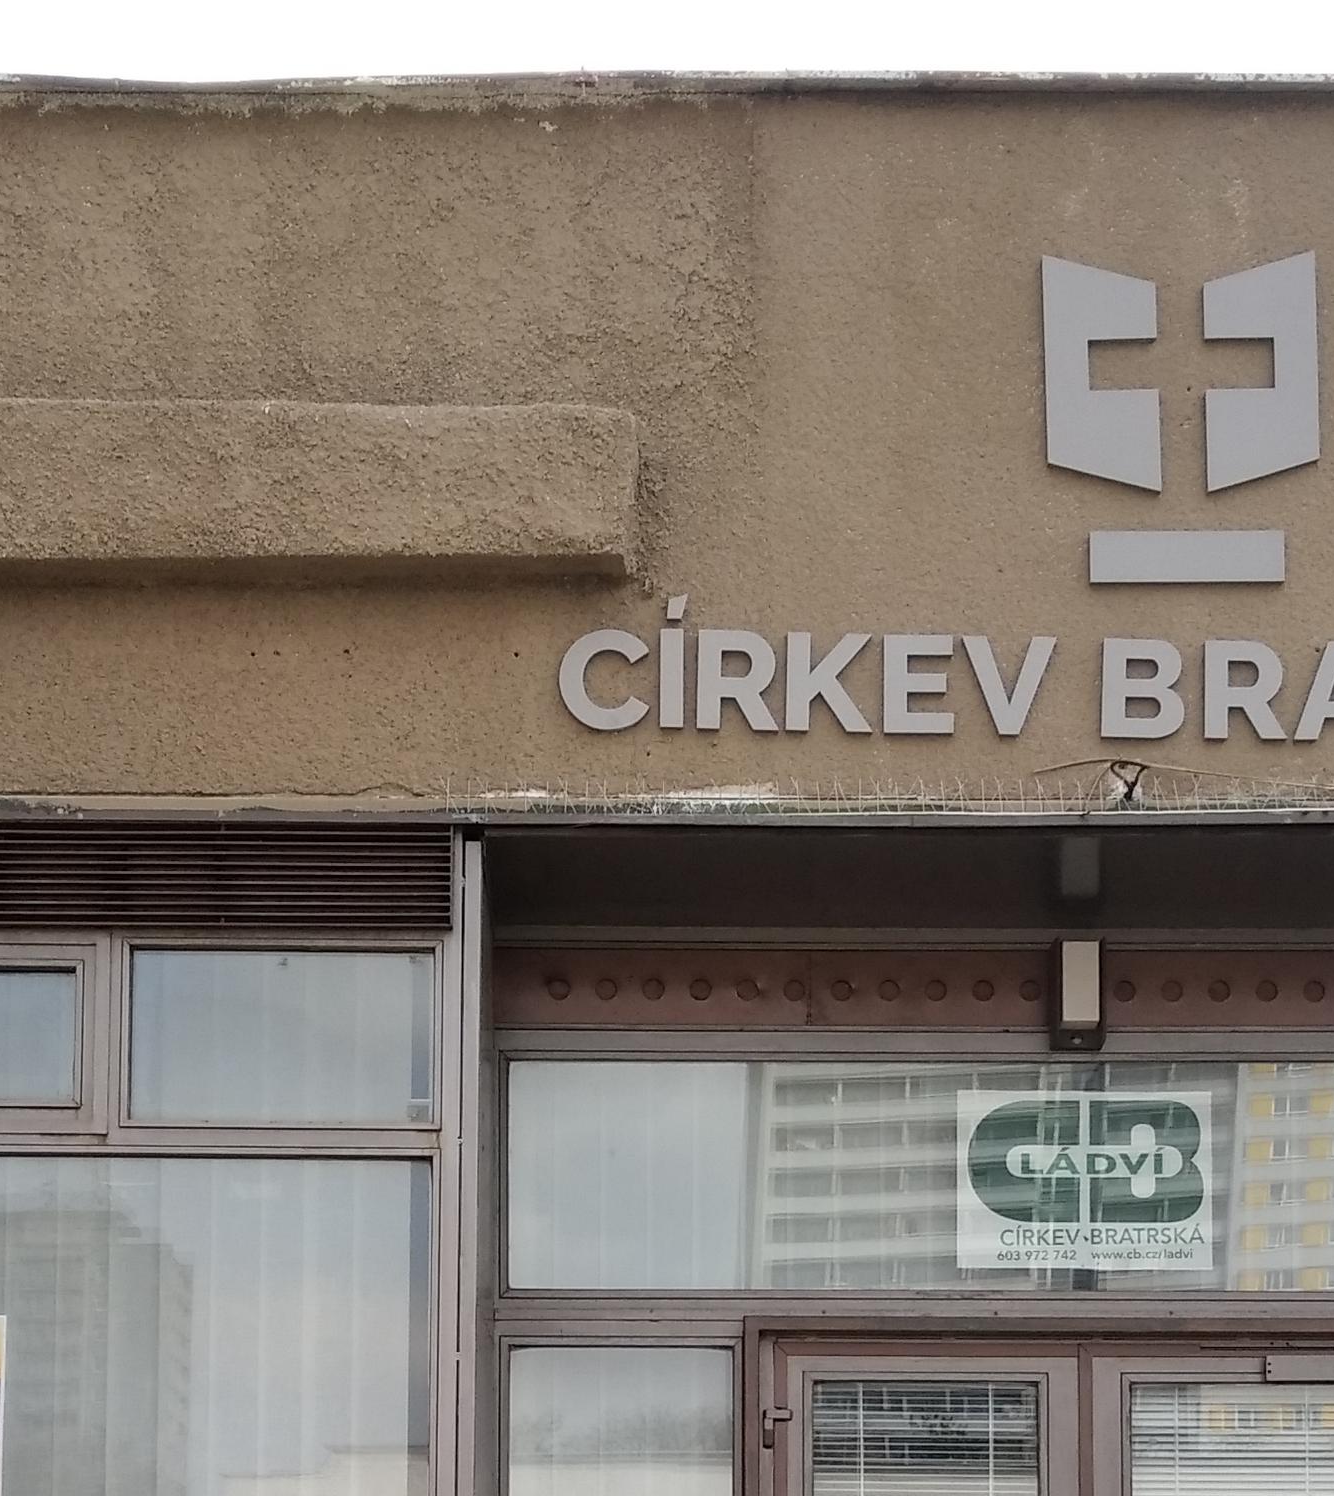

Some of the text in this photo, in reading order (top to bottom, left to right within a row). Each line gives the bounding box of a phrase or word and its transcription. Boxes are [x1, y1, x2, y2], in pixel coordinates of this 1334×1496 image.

[558, 594, 1056, 736] CÍRKEV
[1020, 1147, 1165, 1175] LÁDVÍ
[1000, 1223, 1205, 1246] CÍRKEV BRATRSKÁ
[997, 1248, 1194, 1261] 603 972 742 www.cb.cz/ladvi
